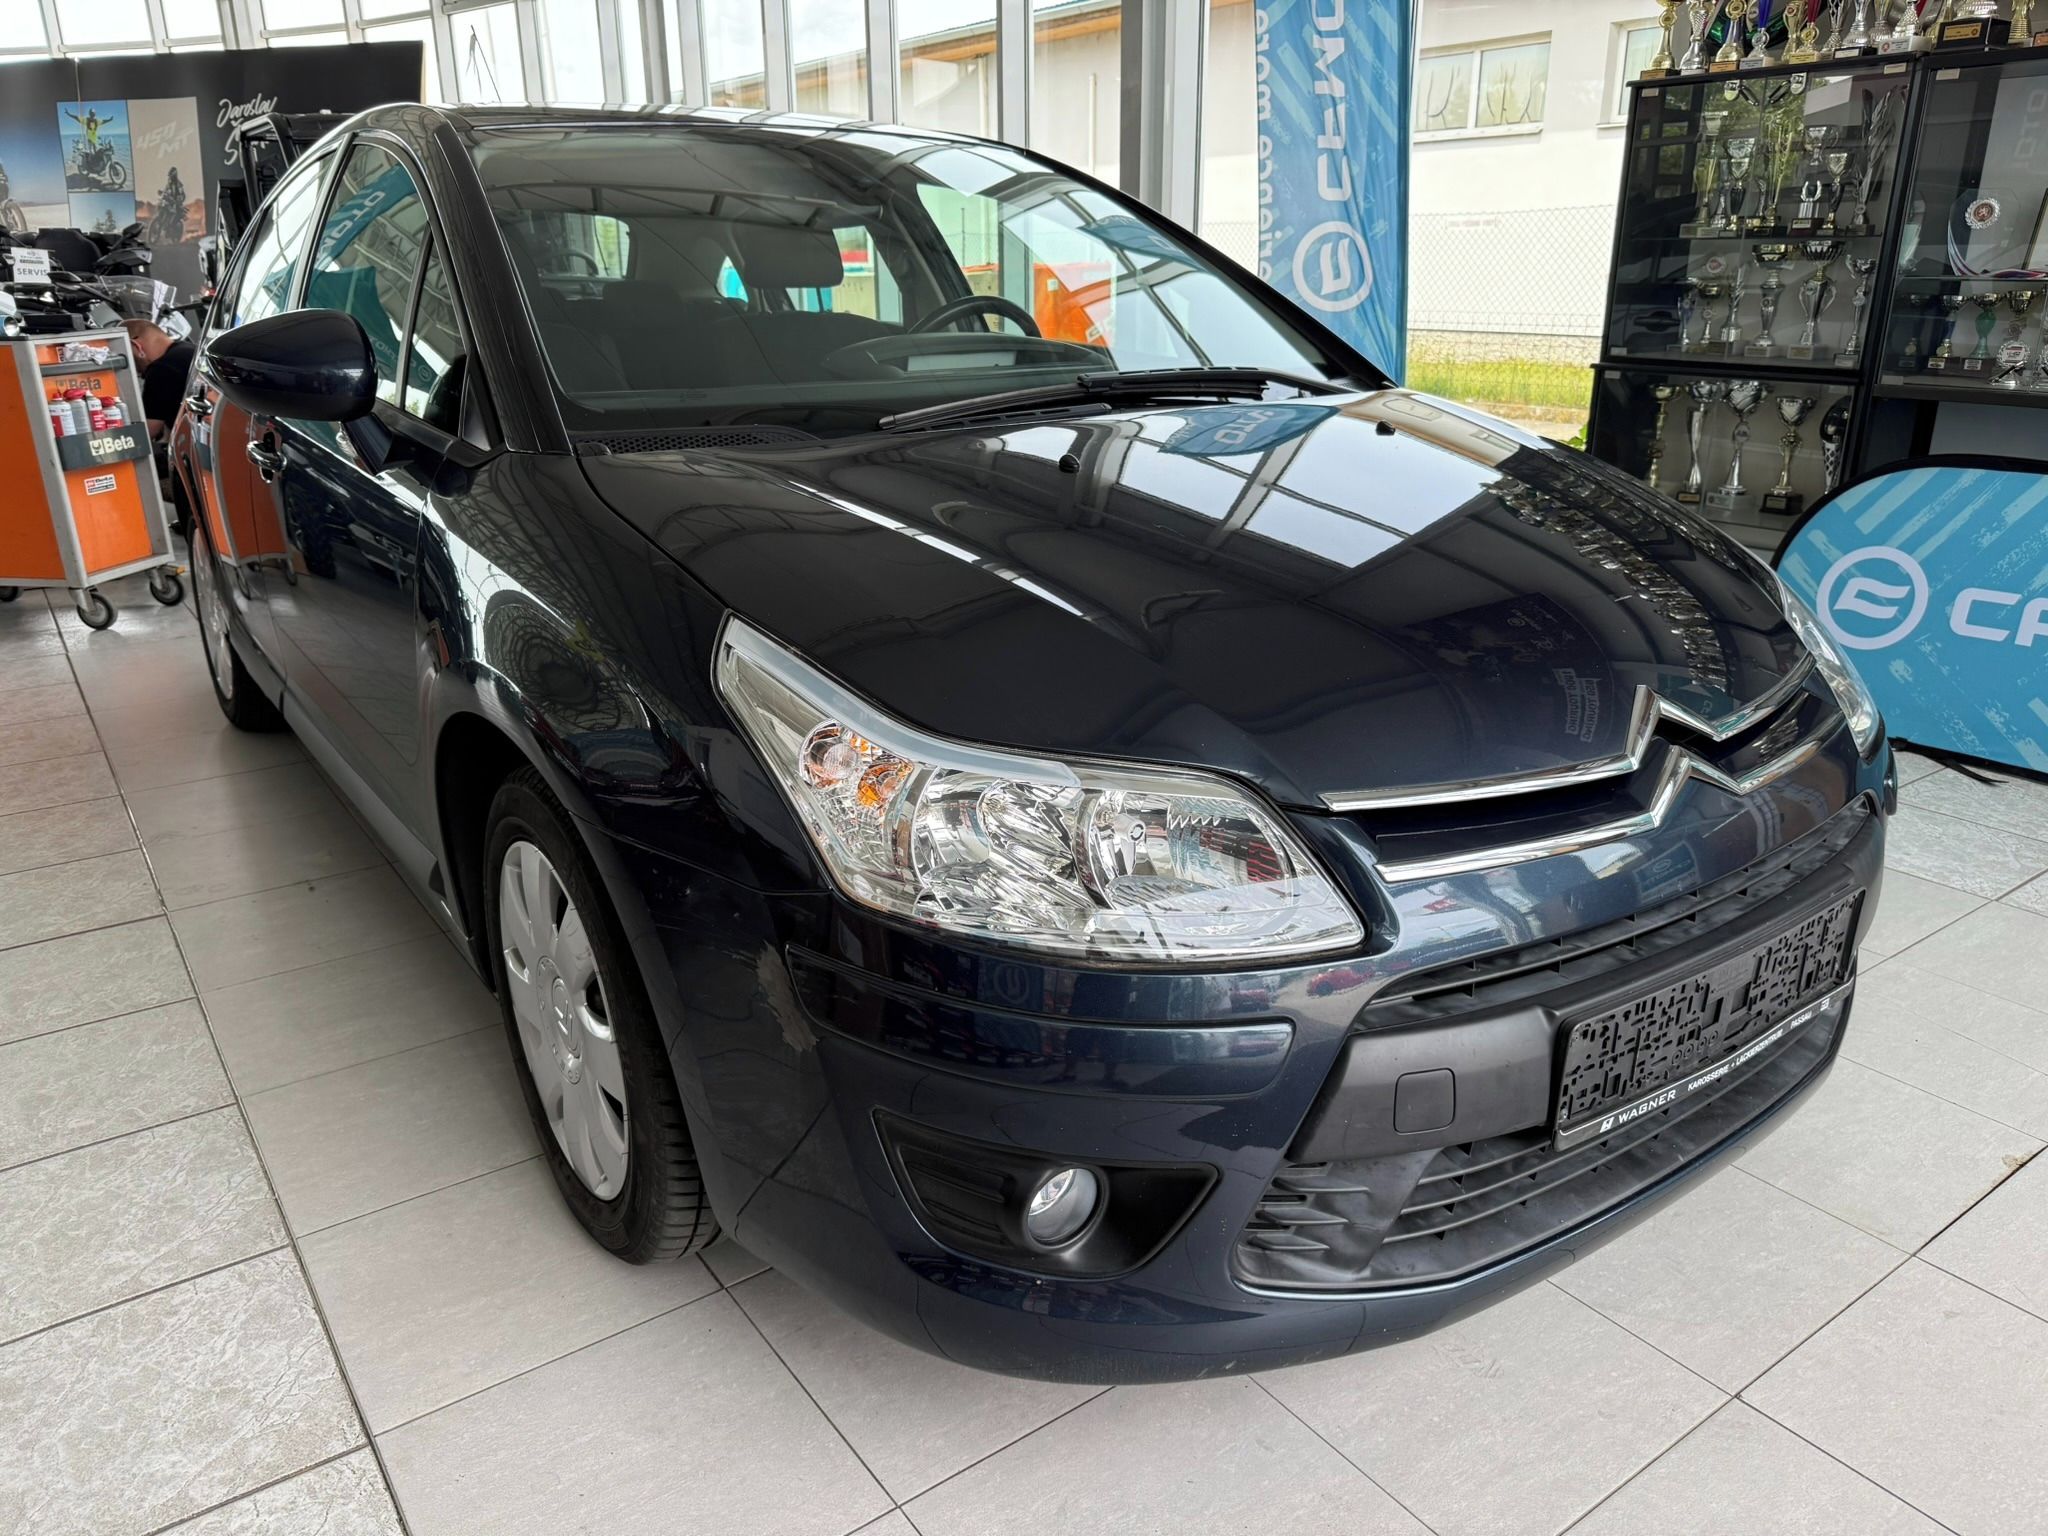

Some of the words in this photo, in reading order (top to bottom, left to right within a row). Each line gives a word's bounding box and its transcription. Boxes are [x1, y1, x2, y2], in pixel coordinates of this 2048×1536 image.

[216, 93, 278, 128] Jaroslav
[16, 268, 49, 276] SERVIS
[103, 434, 135, 454] Beta
[1618, 1089, 1677, 1124] WAGNER
[1687, 1065, 1729, 1092] KAROSSERIE
[1790, 1012, 1812, 1029] PASSAU
